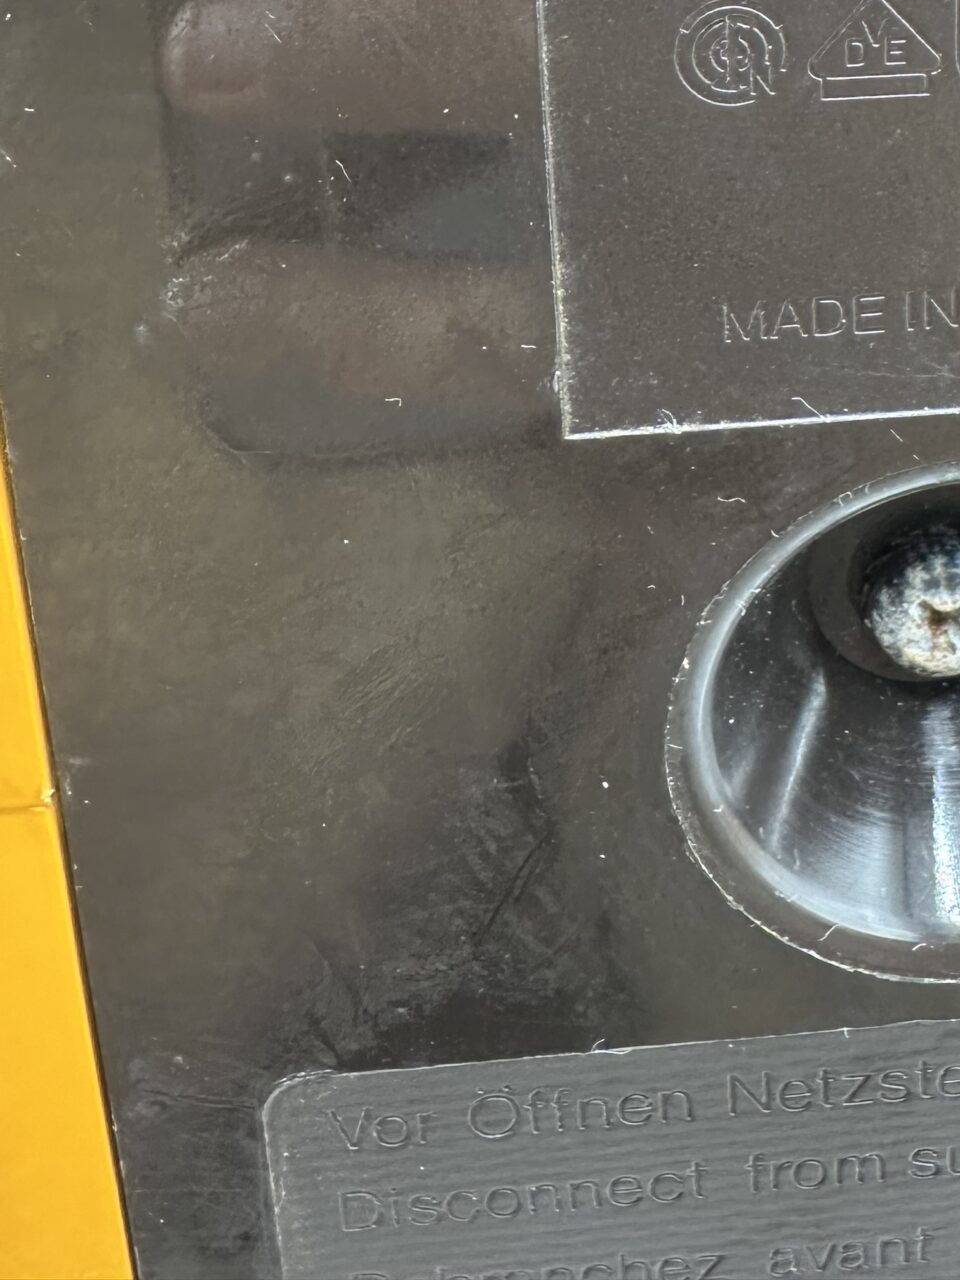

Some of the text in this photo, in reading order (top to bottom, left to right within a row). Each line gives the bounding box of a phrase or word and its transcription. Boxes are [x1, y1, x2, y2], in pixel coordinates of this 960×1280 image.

[720, 290, 889, 344] MADE
[903, 286, 960, 332] IN
[327, 1104, 437, 1151] Vor
[467, 1082, 698, 1140] Öffnen
[336, 1158, 708, 1232] Disconnect
[745, 1146, 887, 1192] from
[768, 1223, 938, 1276] avant
